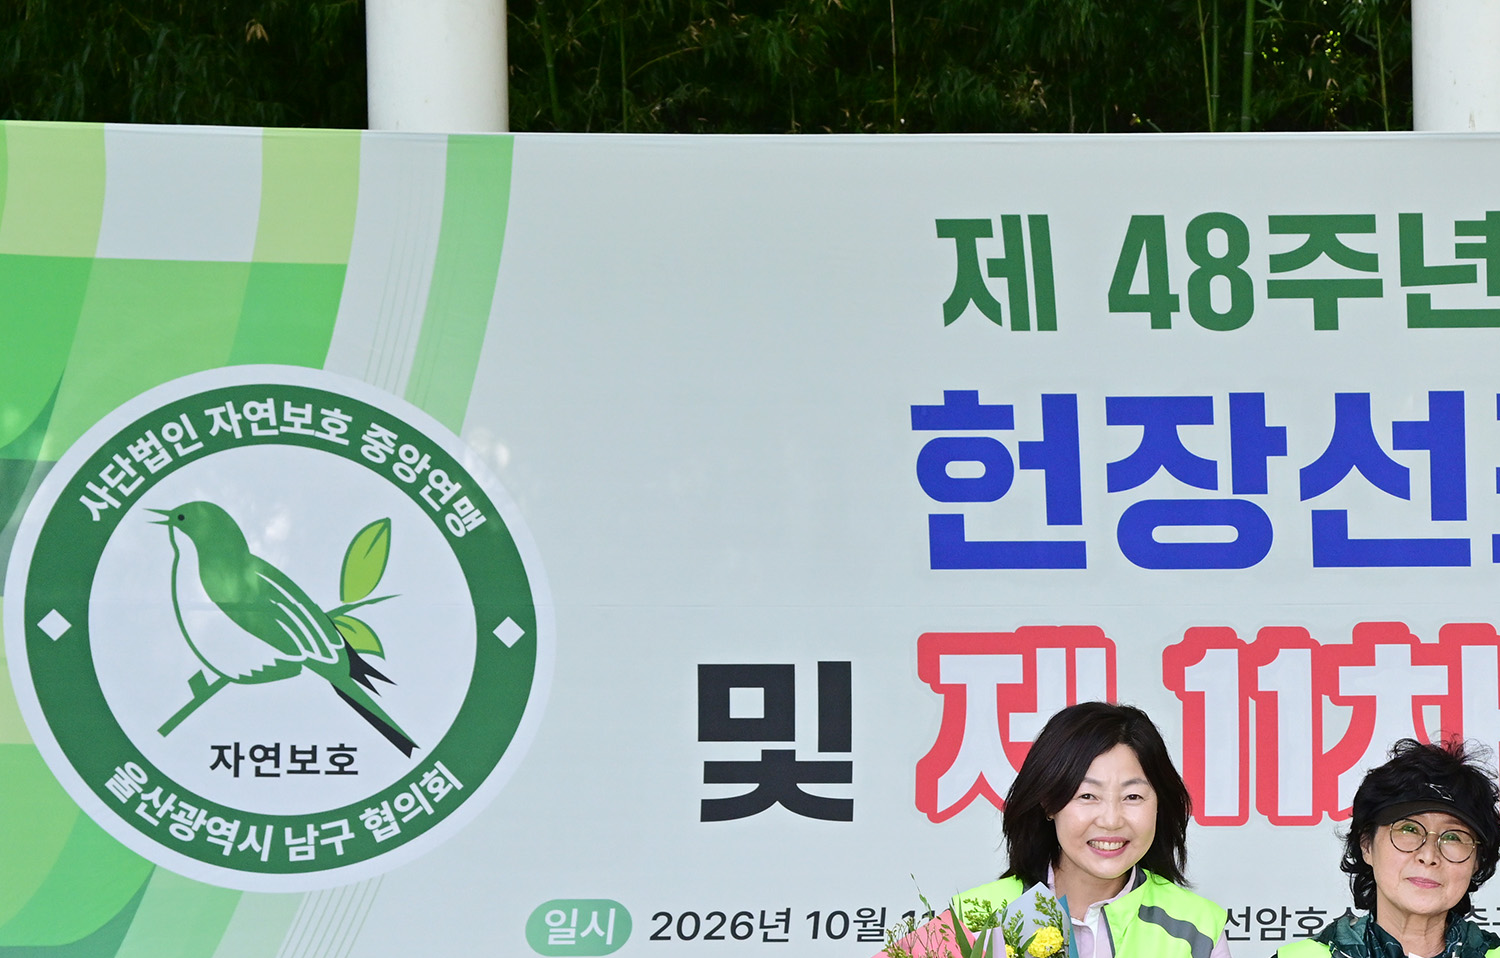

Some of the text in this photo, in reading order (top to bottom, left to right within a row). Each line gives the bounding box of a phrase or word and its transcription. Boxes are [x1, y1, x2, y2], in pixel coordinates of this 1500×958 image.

[936, 213, 1059, 333] 제
[78, 397, 487, 538] 사단법인 자연보호 중앙연맹
[208, 741, 360, 778] 자연보호
[696, 659, 854, 823] 및
[916, 626, 1117, 823] 제
[103, 759, 464, 863] 울산광역시 남구 협의회
[543, 908, 617, 946] 일시
[649, 906, 792, 943] 2026년
[805, 906, 888, 943] 10월
